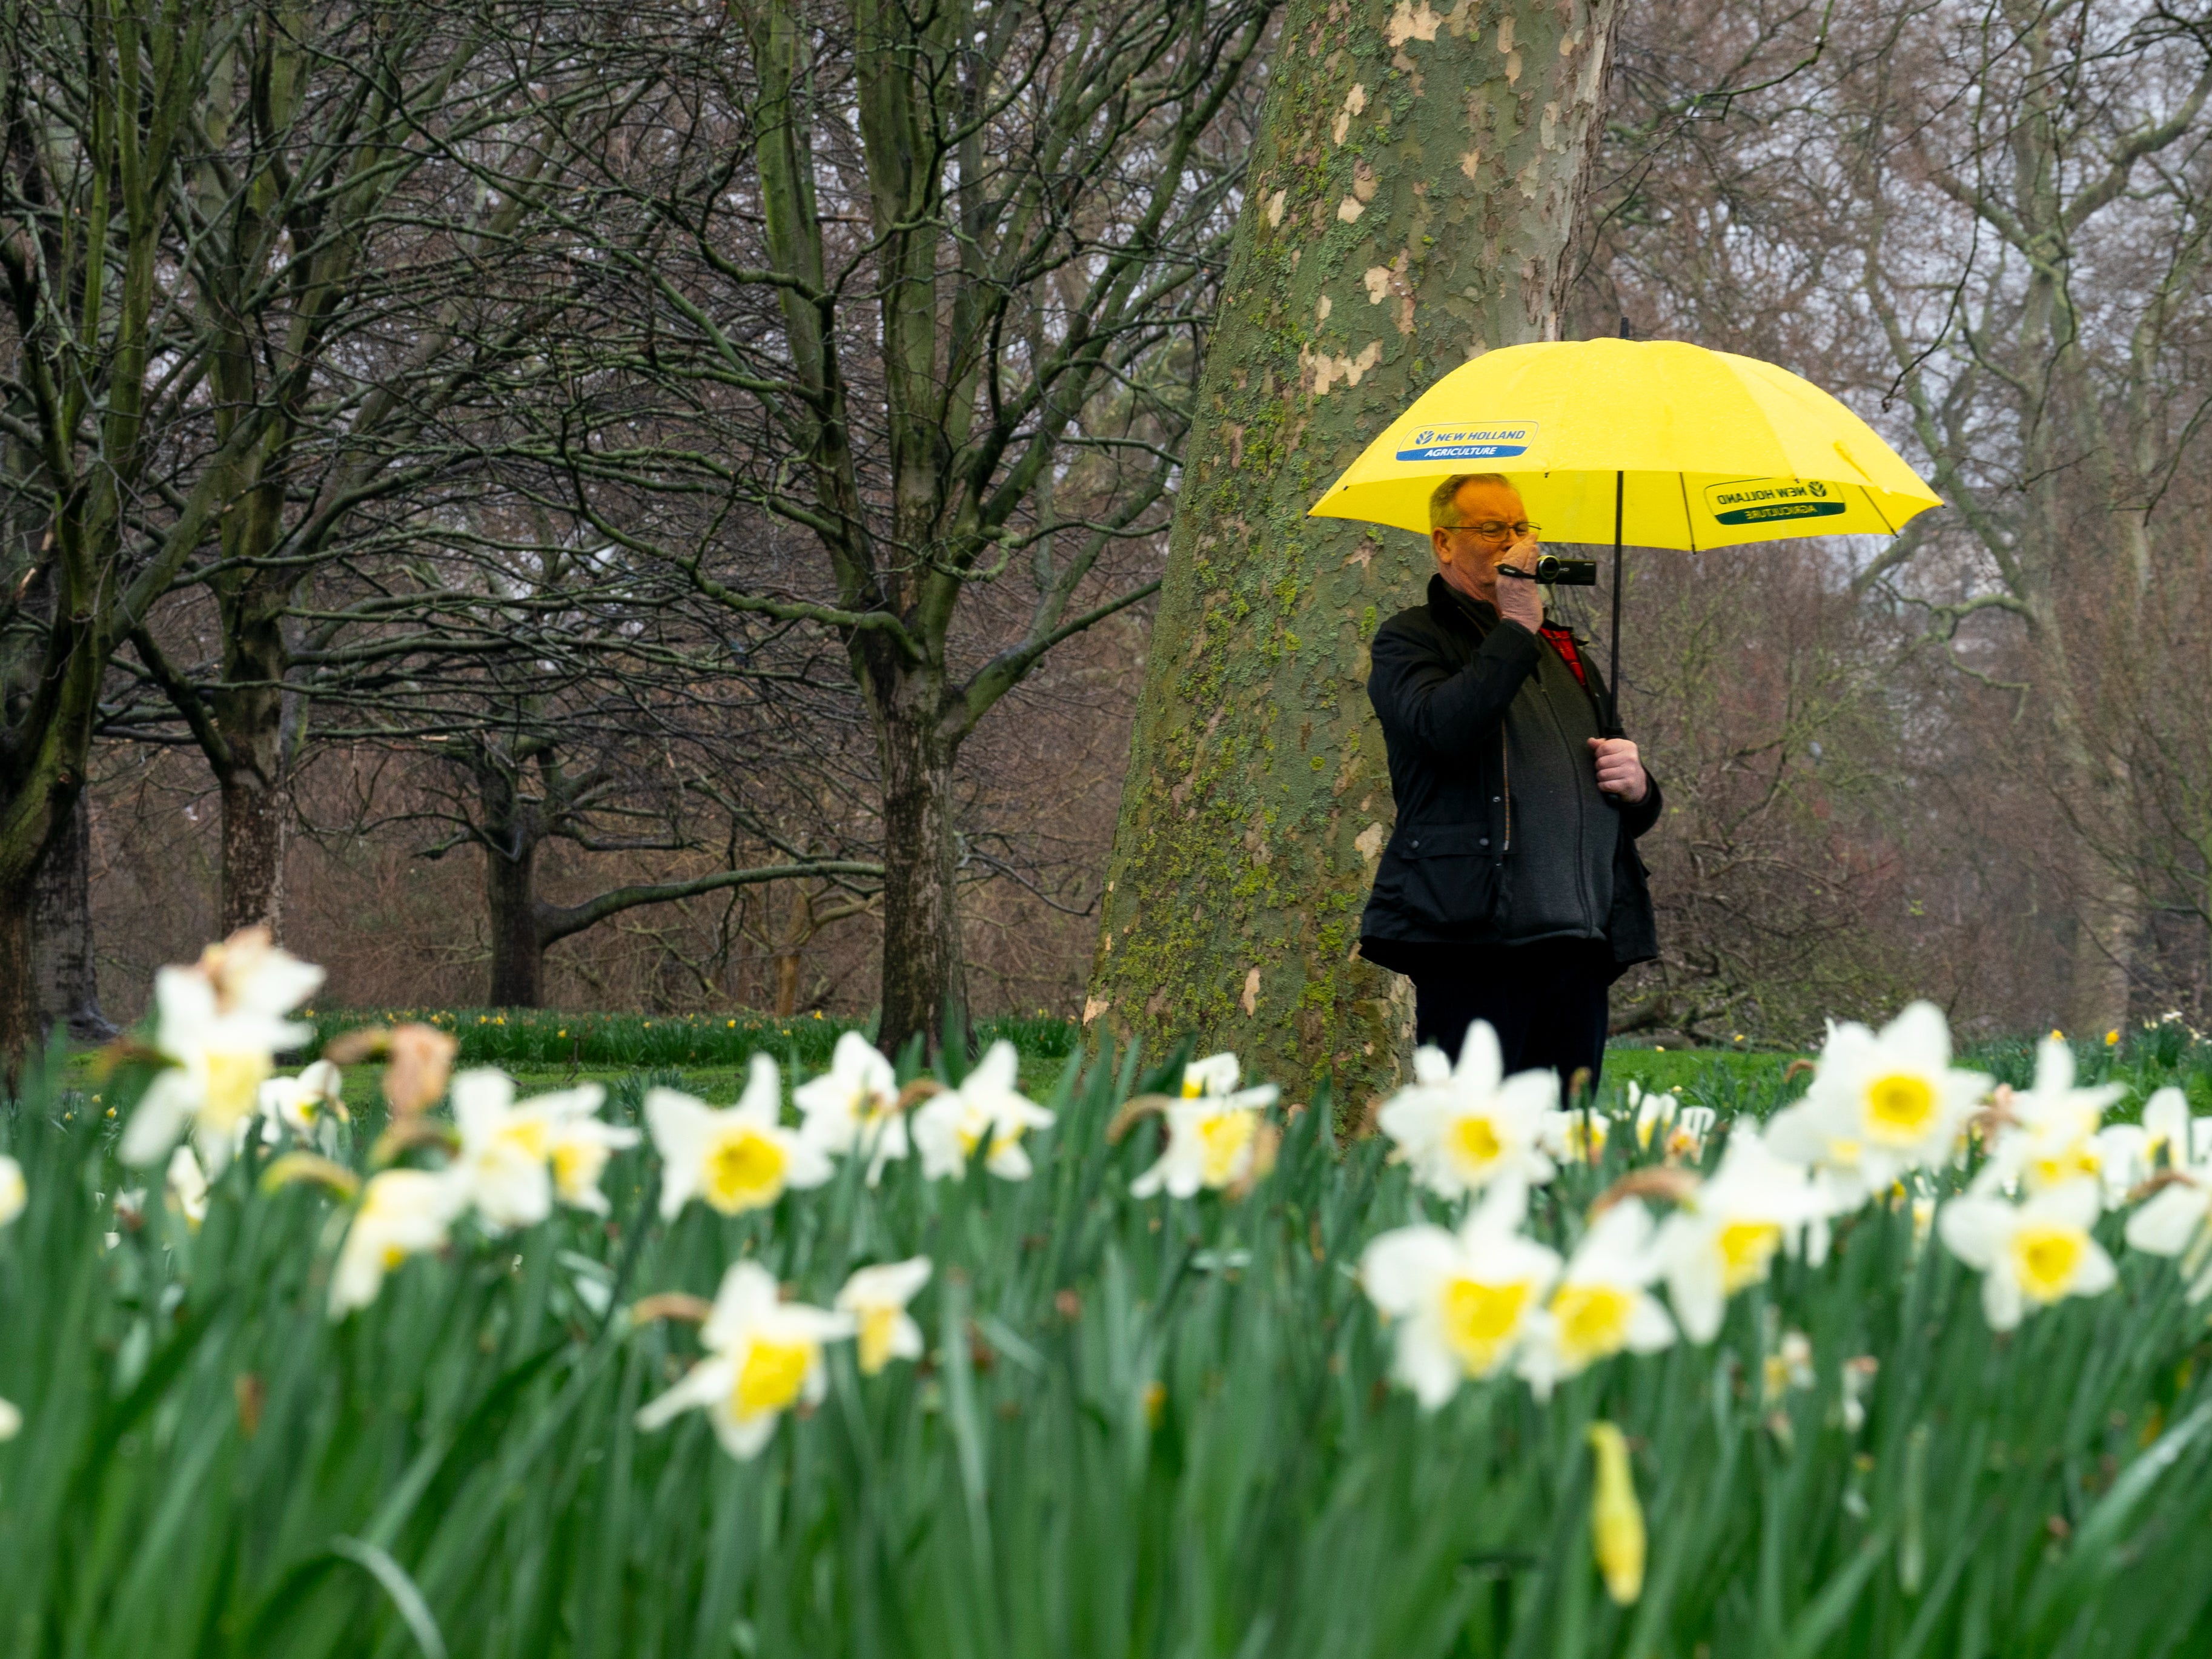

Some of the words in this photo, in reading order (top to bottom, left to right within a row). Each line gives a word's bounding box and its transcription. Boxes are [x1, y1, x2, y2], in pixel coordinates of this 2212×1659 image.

[1435, 432, 1467, 442] NEW
[1468, 430, 1526, 440] HOLLAND
[1424, 447, 1497, 457] AGRICULTURE
